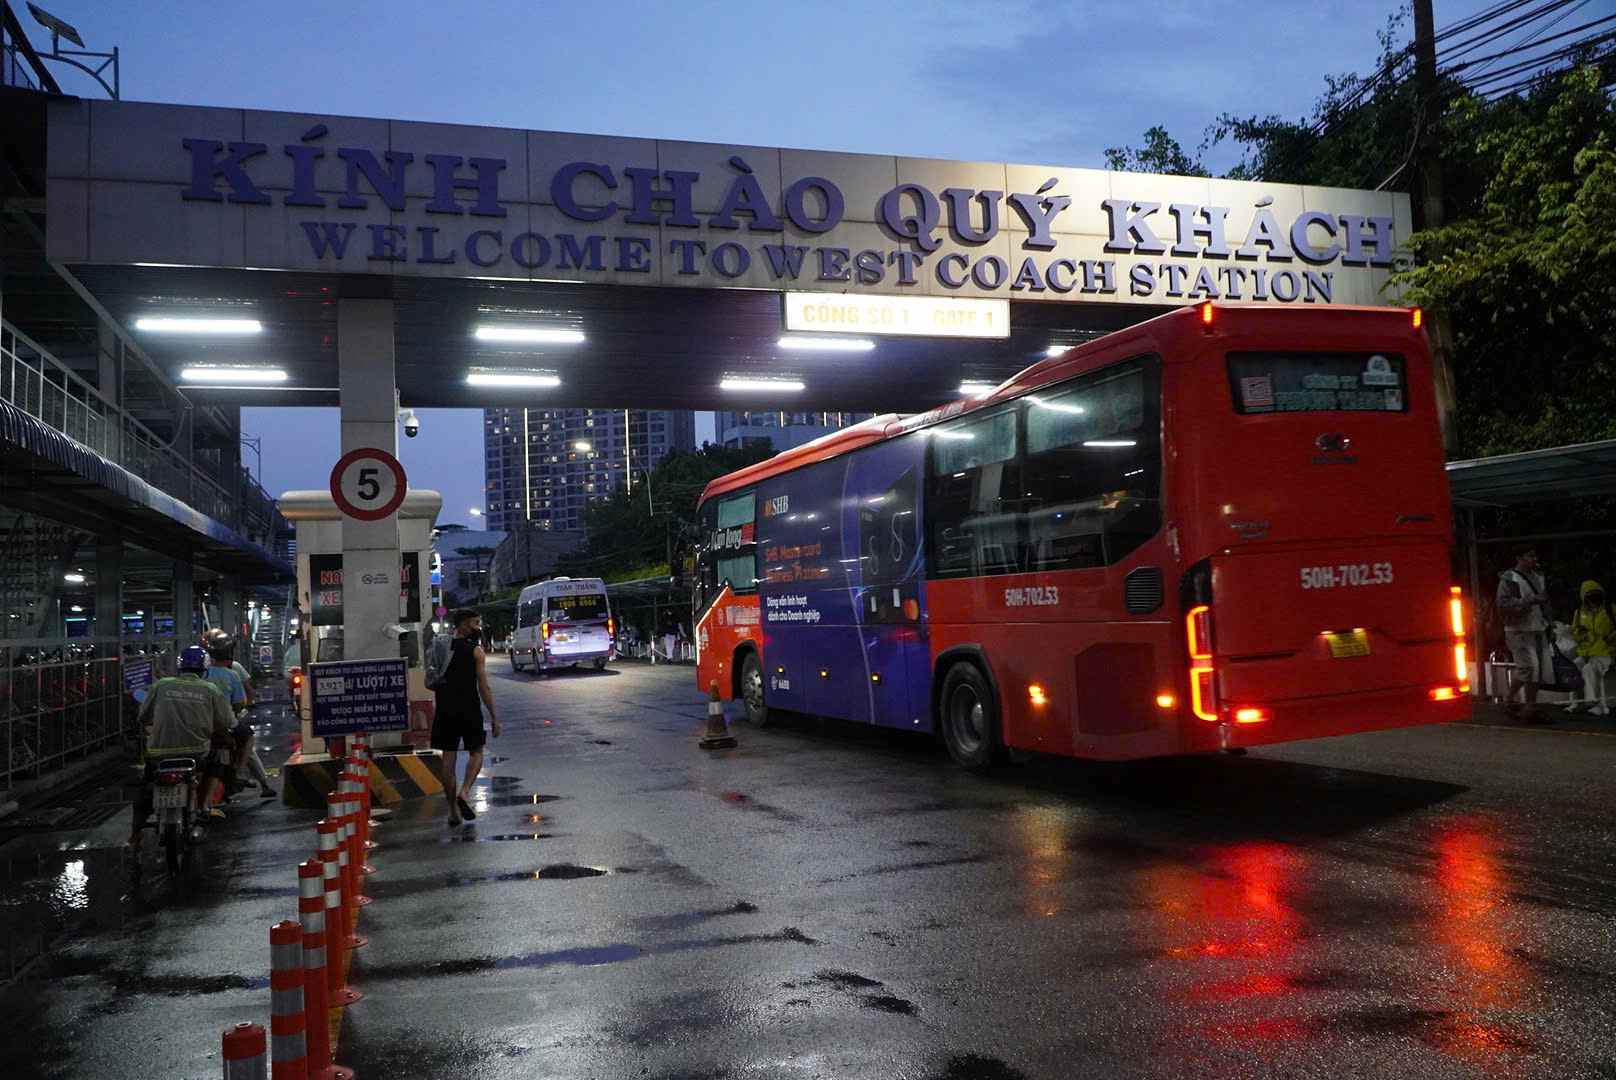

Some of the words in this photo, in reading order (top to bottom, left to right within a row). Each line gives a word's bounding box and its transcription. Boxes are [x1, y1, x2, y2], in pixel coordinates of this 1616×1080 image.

[181, 124, 507, 217] KÍNH
[550, 156, 844, 233] CHÀO
[881, 177, 1071, 251] QUÝ
[1104, 195, 1393, 267] KHÁCH
[301, 222, 651, 273] WELCOME
[671, 239, 751, 278] TO
[762, 244, 925, 287] WEST
[937, 252, 1116, 294] COACH
[1131, 264, 1335, 303] STATION
[358, 468, 380, 500] 5
[772, 495, 789, 515] SHB
[1300, 562, 1393, 590] 50H-702.53
[1005, 585, 1059, 606] 50H-702.53
[390, 674, 405, 687] XE
